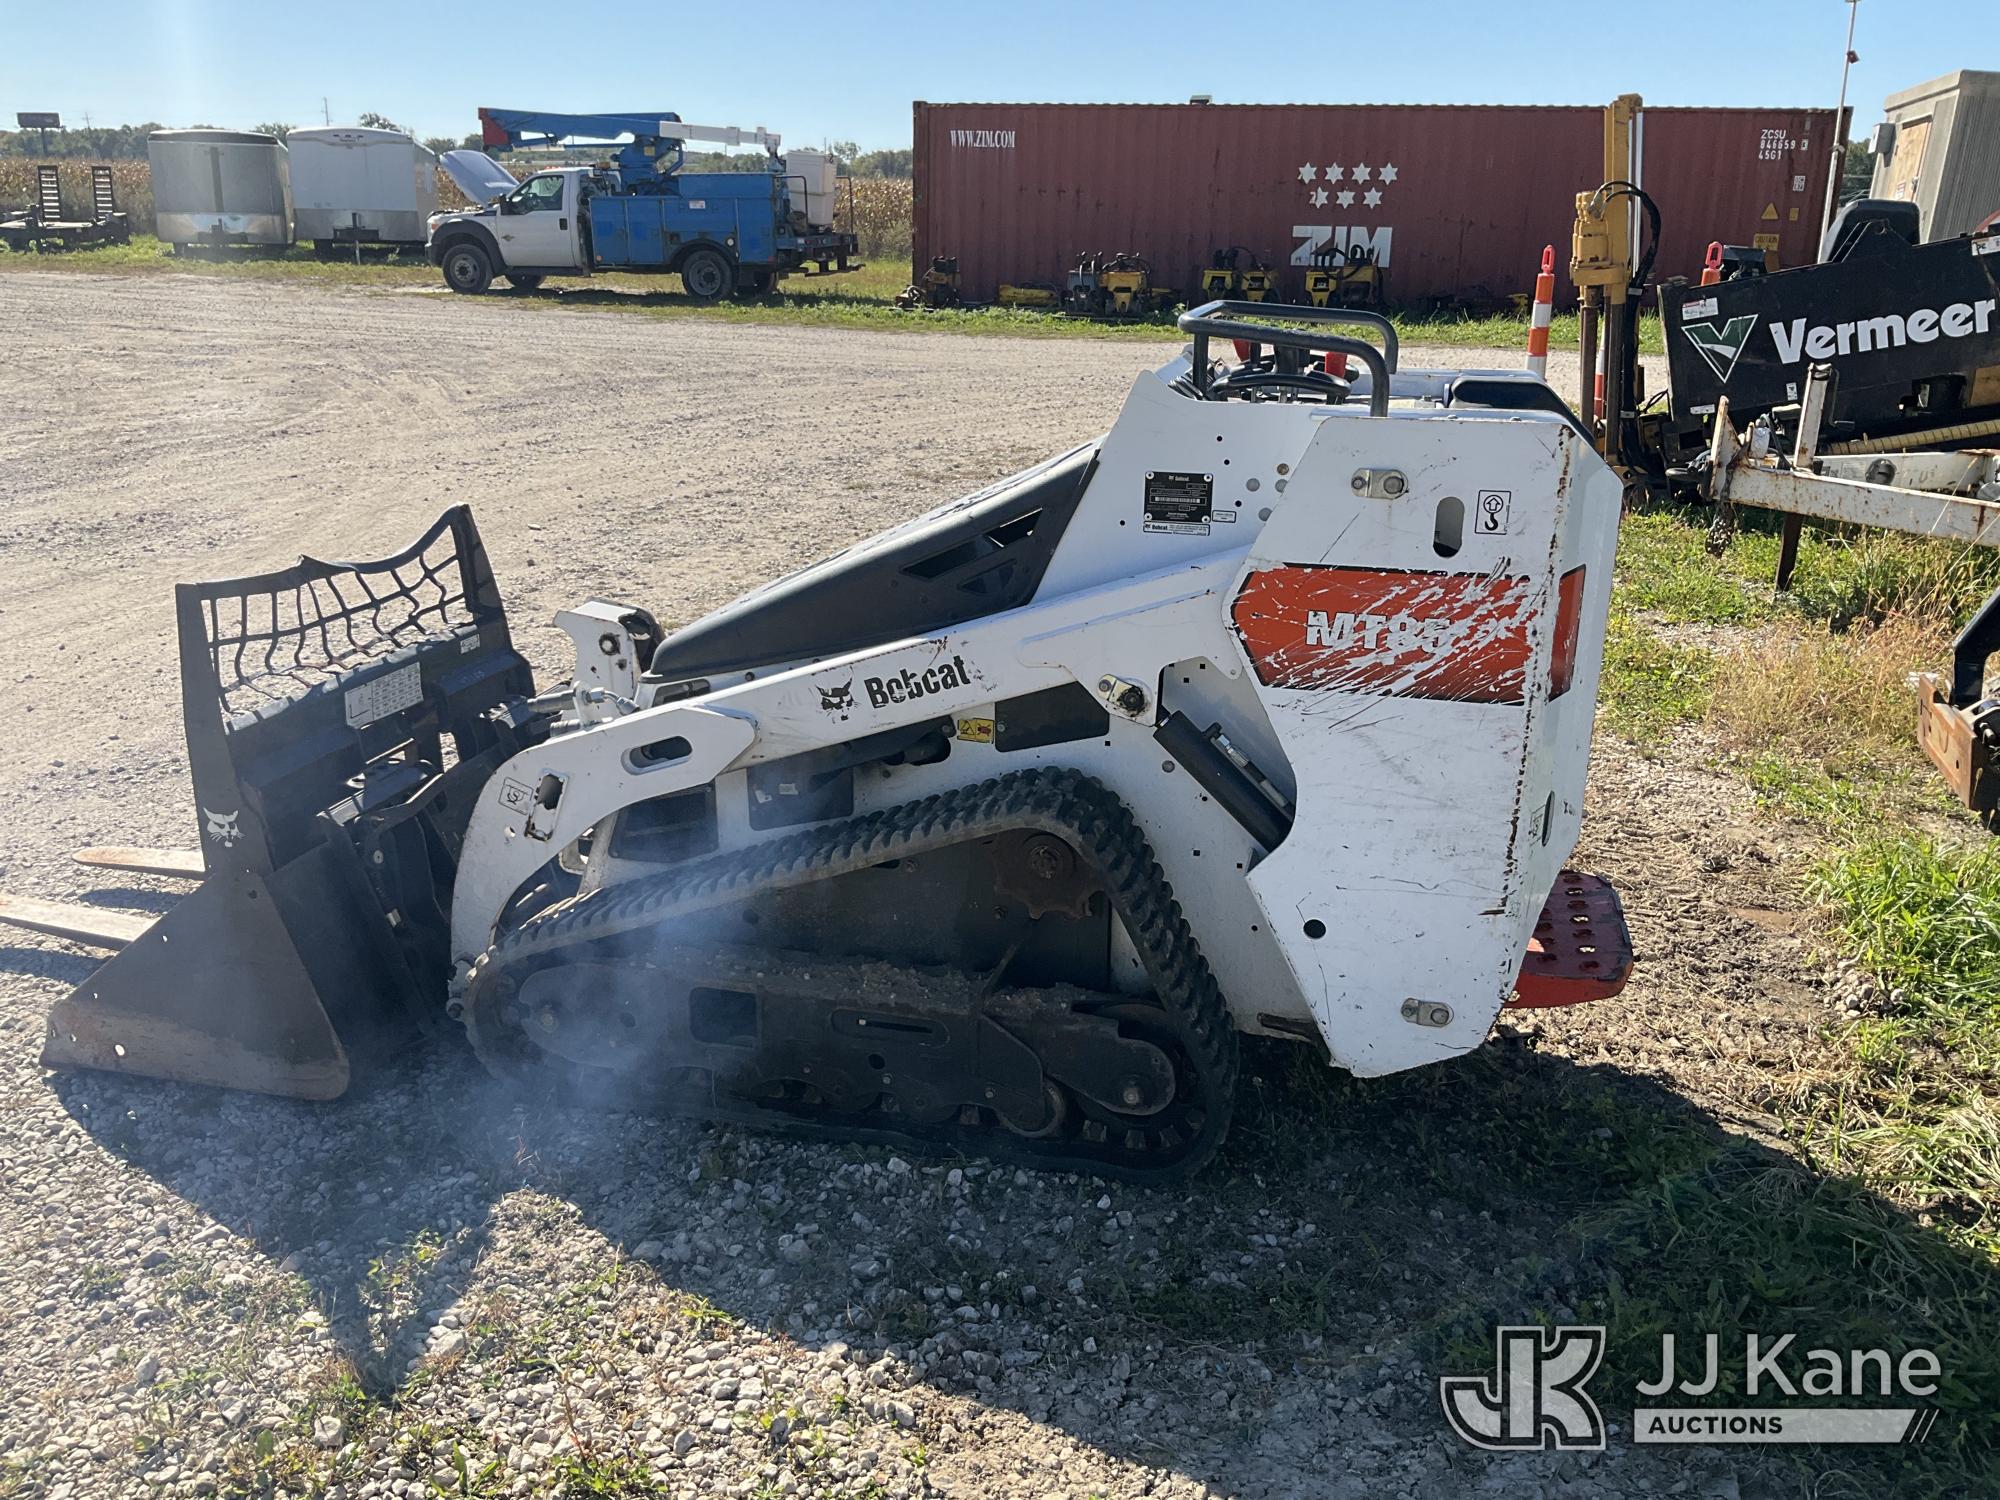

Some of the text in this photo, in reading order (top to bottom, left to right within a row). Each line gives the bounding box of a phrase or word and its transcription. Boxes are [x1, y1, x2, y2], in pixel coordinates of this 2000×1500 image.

[950, 130, 1016, 148] WWW.ZIM.COM
[1761, 129, 1787, 139] ZCSU
[1290, 225, 1393, 268] ZIM
[1769, 299, 1996, 364] Vermeer
[863, 655, 971, 709] Bobcat
